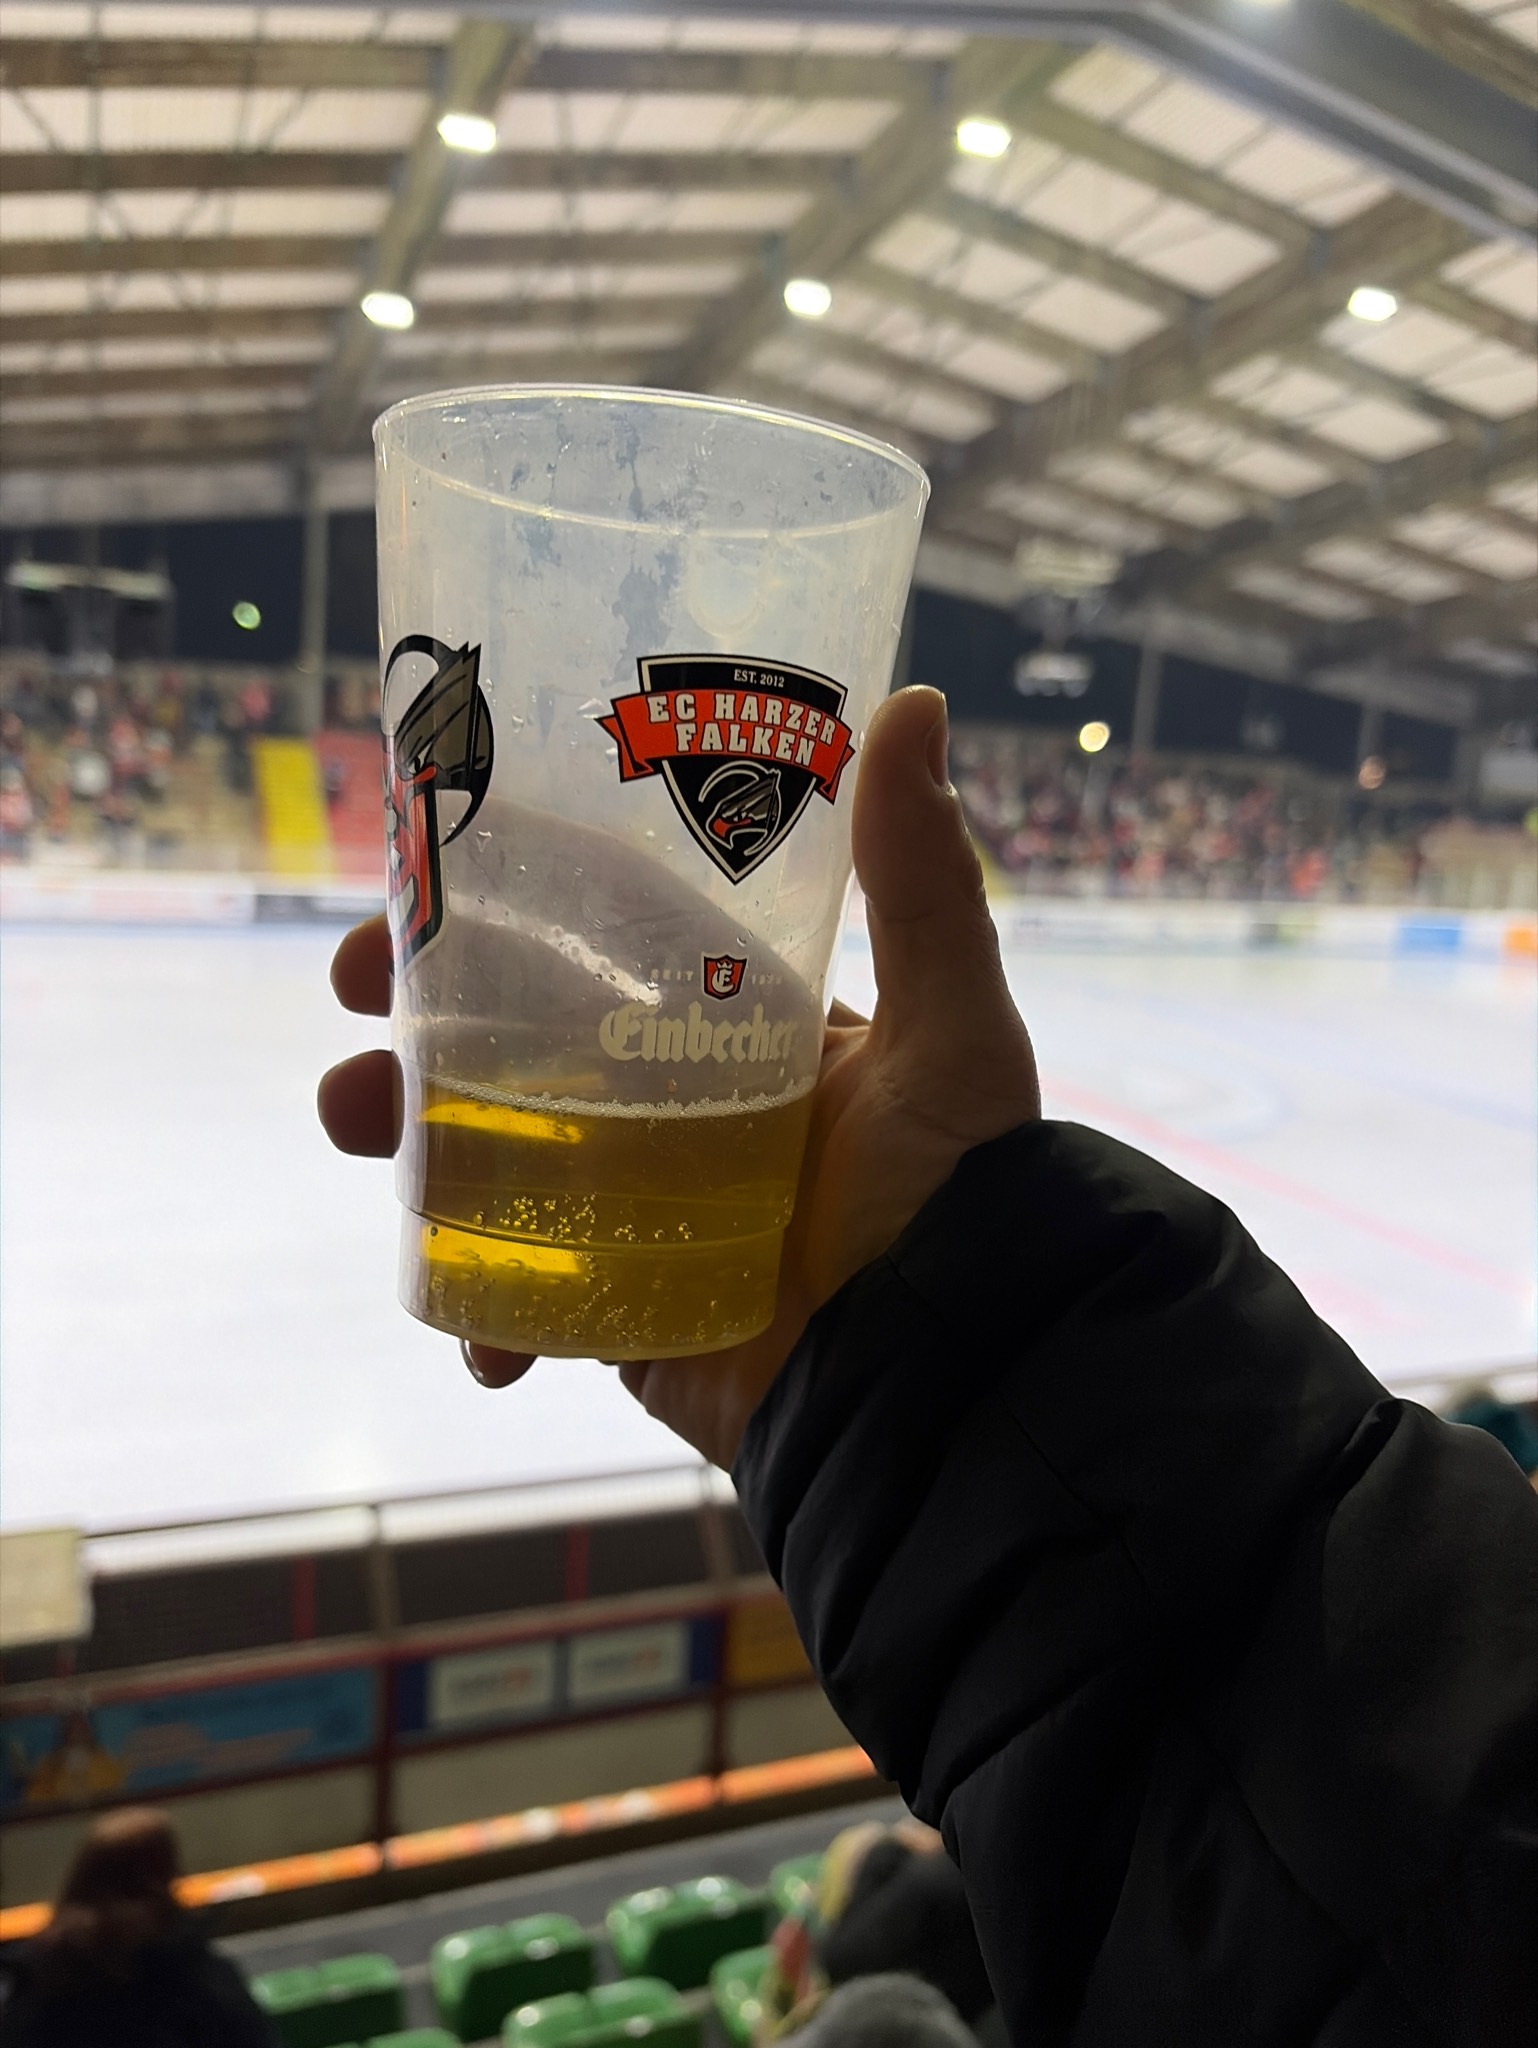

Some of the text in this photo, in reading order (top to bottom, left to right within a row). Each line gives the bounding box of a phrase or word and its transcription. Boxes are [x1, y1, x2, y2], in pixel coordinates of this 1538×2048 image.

[733, 668, 785, 688] EST. 2012
[647, 692, 836, 745] EC HARZER
[675, 722, 816, 767] FALKEN
